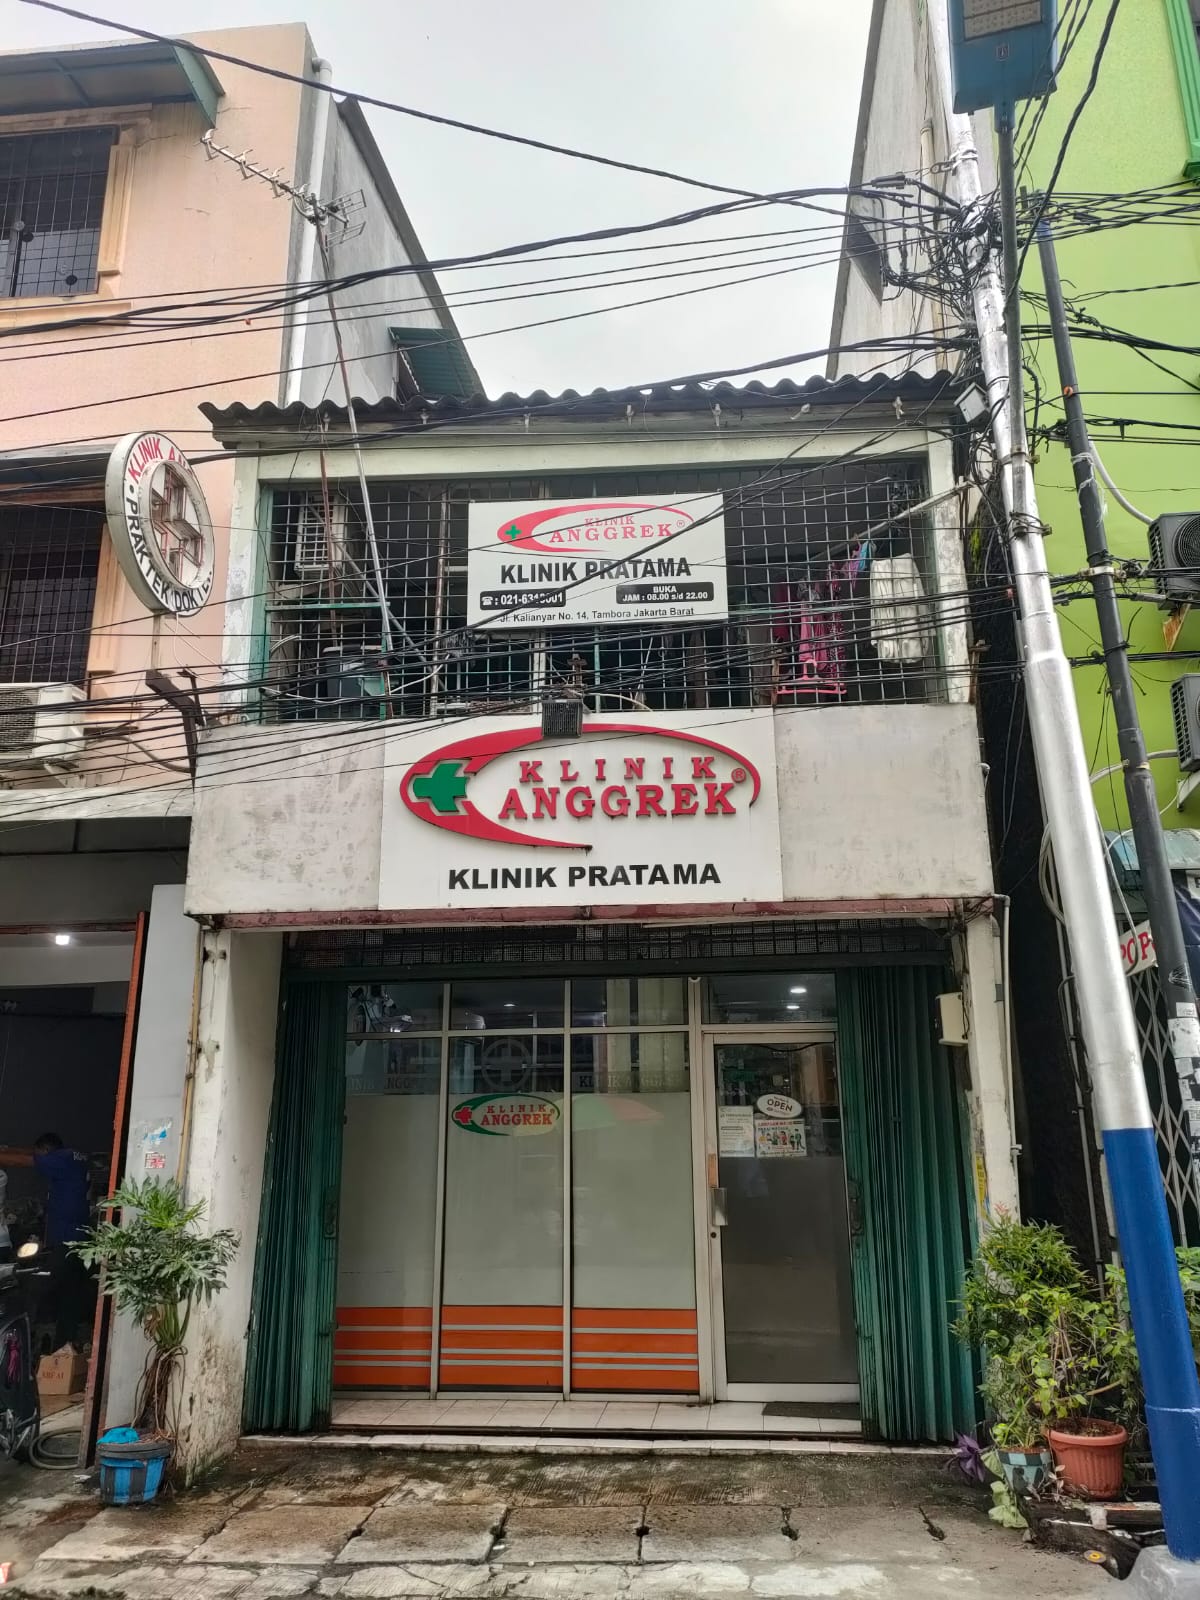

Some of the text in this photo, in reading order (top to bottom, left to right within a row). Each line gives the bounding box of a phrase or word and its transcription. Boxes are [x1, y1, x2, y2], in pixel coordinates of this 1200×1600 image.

[128, 437, 163, 484] KLINIK
[584, 515, 634, 527] KLINIK
[549, 523, 674, 543] ANGGREK
[126, 497, 169, 605] PRAKTEK
[501, 557, 692, 584] KLINIK PRATAMA
[622, 594, 640, 602] JAM
[686, 591, 708, 600] 22.00
[653, 585, 677, 593] BUKA
[513, 613, 556, 624] Kalianyar
[558, 611, 573, 621] No.
[592, 608, 631, 619] Tambora
[634, 608, 667, 618] Jakarta
[670, 607, 694, 616] Barat
[519, 756, 717, 783] KLINIK
[498, 782, 737, 819] ANGGREK
[448, 863, 721, 890] KLINIK PRATAMA
[486, 1104, 547, 1114] KLINIK
[767, 1098, 793, 1112] OPEN
[480, 1113, 553, 1126] ANGGREK
